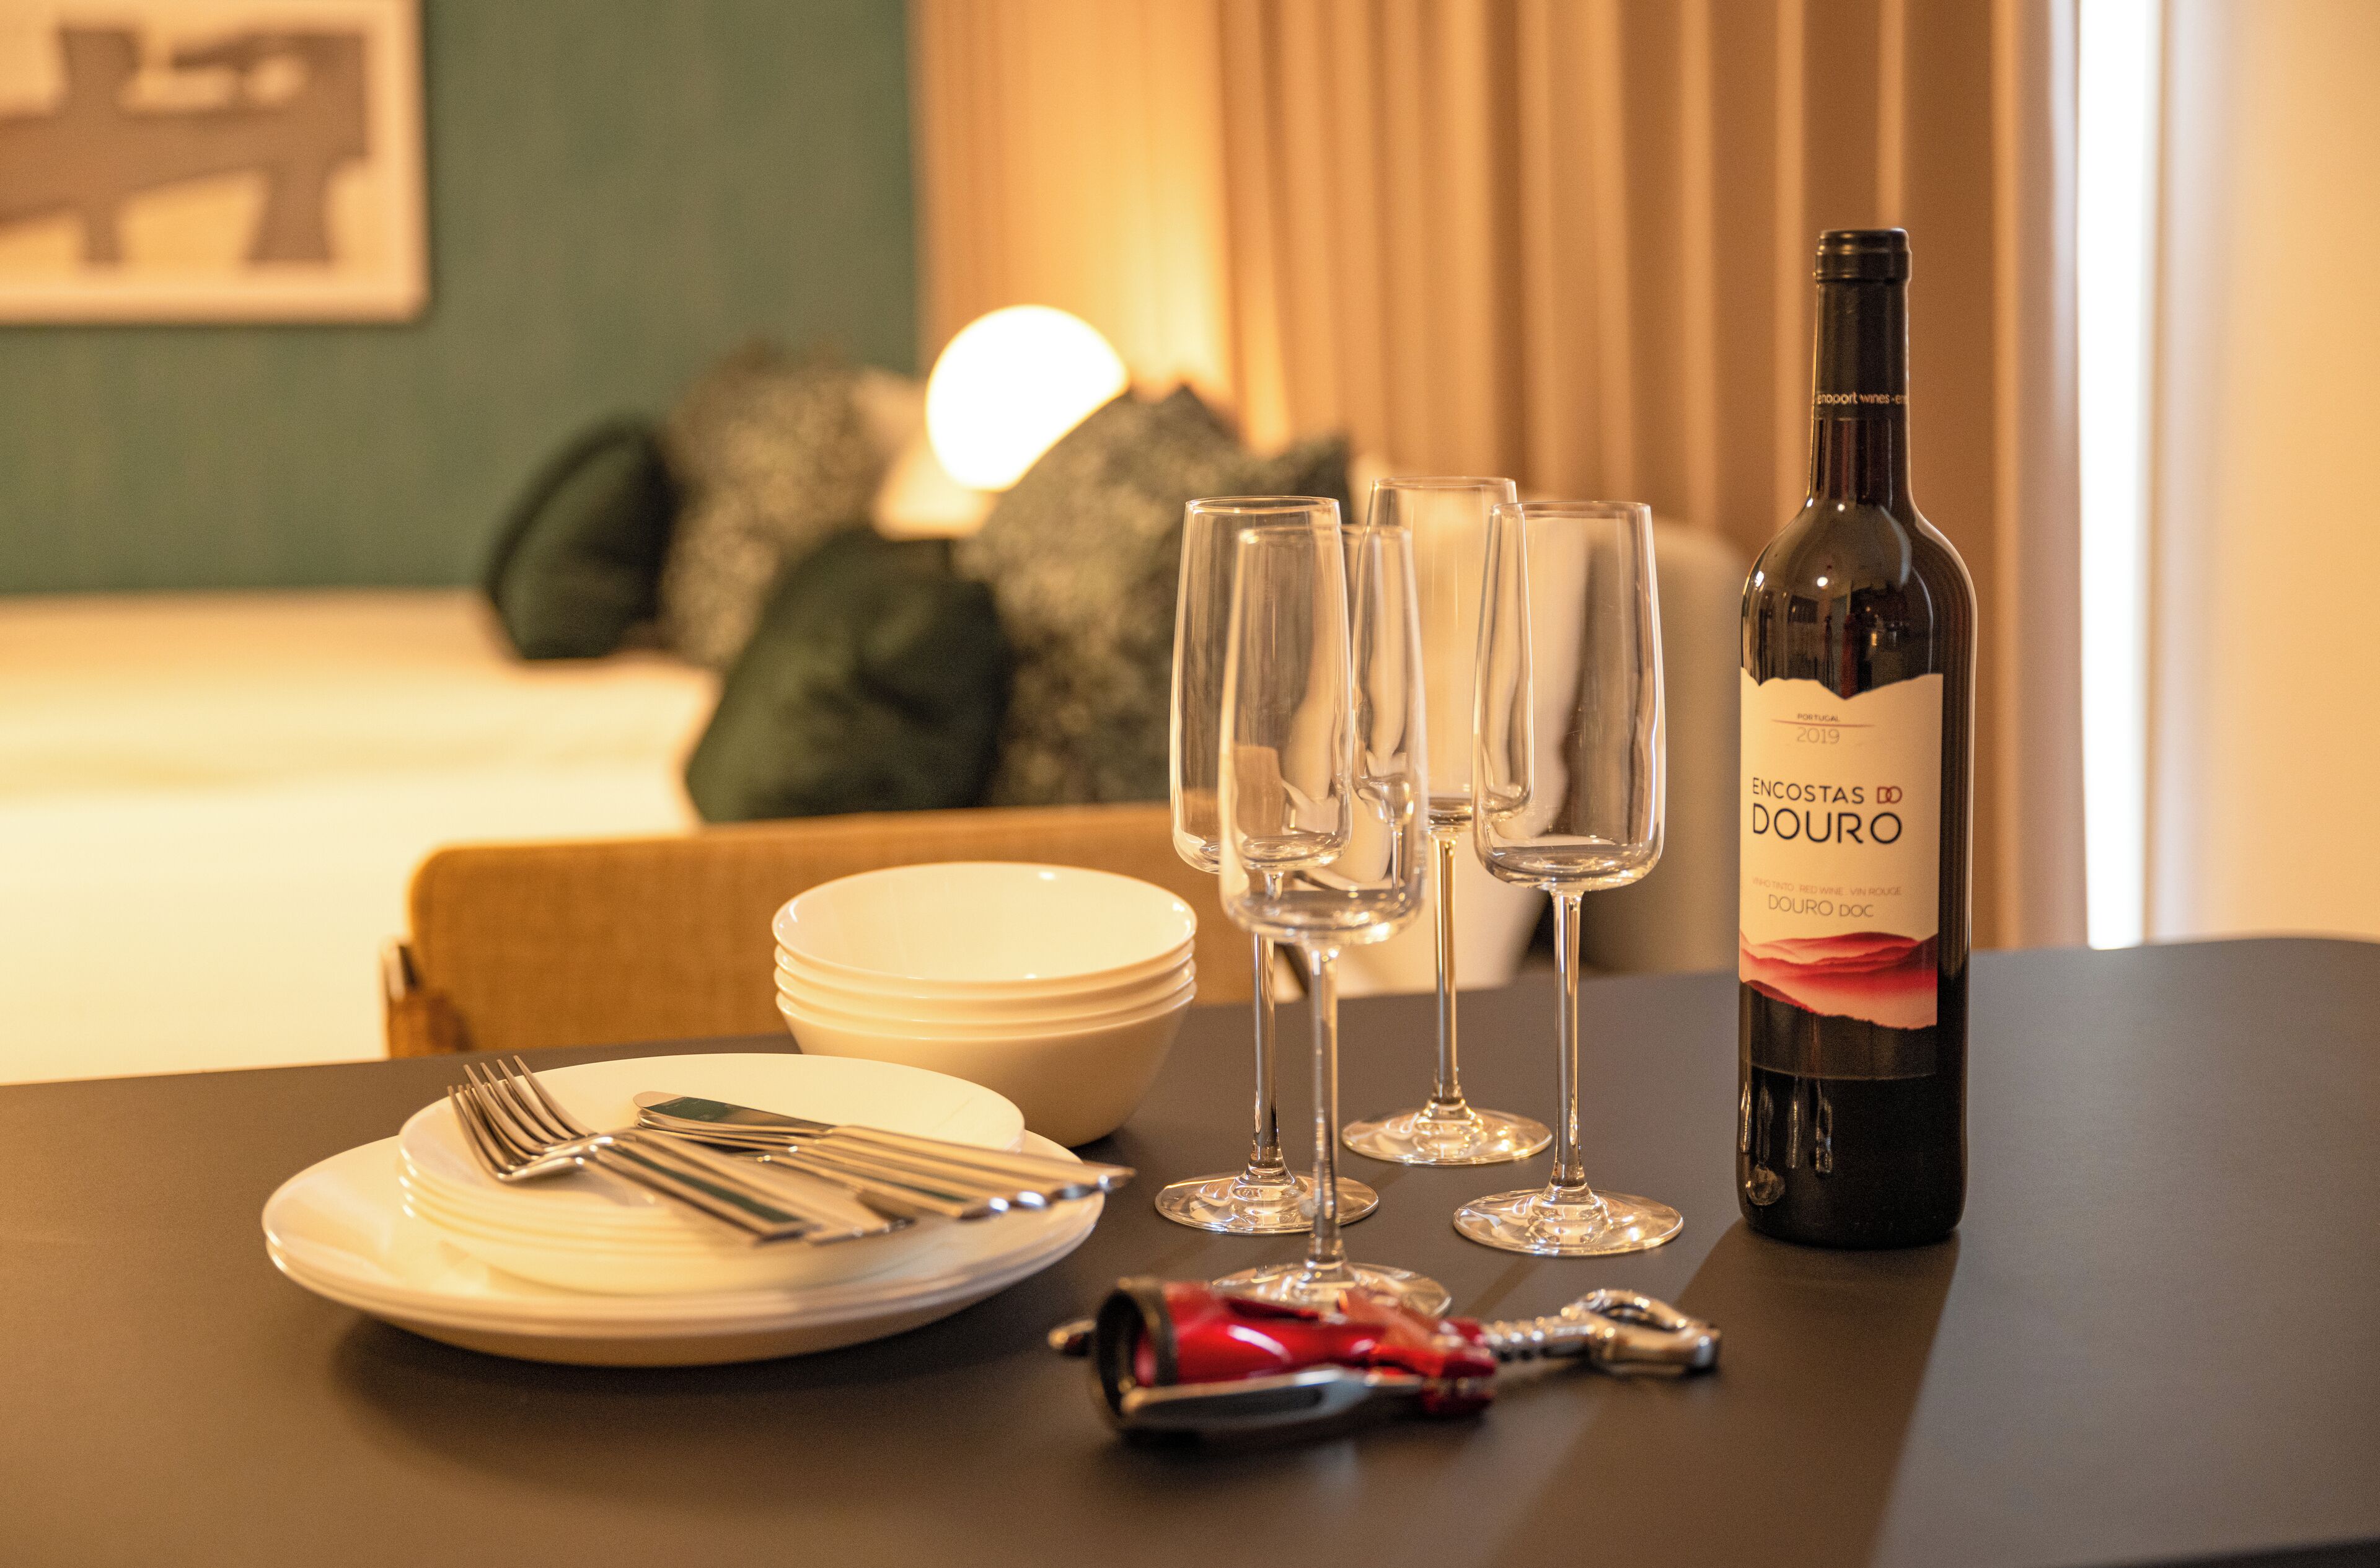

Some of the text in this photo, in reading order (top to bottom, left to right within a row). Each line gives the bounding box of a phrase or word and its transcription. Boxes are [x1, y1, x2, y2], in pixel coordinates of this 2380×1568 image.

[1817, 390, 1858, 406] enoport
[1859, 393, 1890, 404] wines
[1797, 713, 1840, 722] PORTUGAL
[1797, 726, 1840, 744] 2019
[1753, 777, 1903, 804] ENCOSTAS DO
[1753, 803, 1903, 845] DOURO
[1772, 880, 1794, 892] TINTO
[1799, 884, 1818, 894] RED
[1819, 886, 1844, 896] WINE
[1849, 887, 1866, 896] VIN
[1869, 886, 1902, 896] ROUGE
[1768, 894, 1874, 918] DOURO DOC
